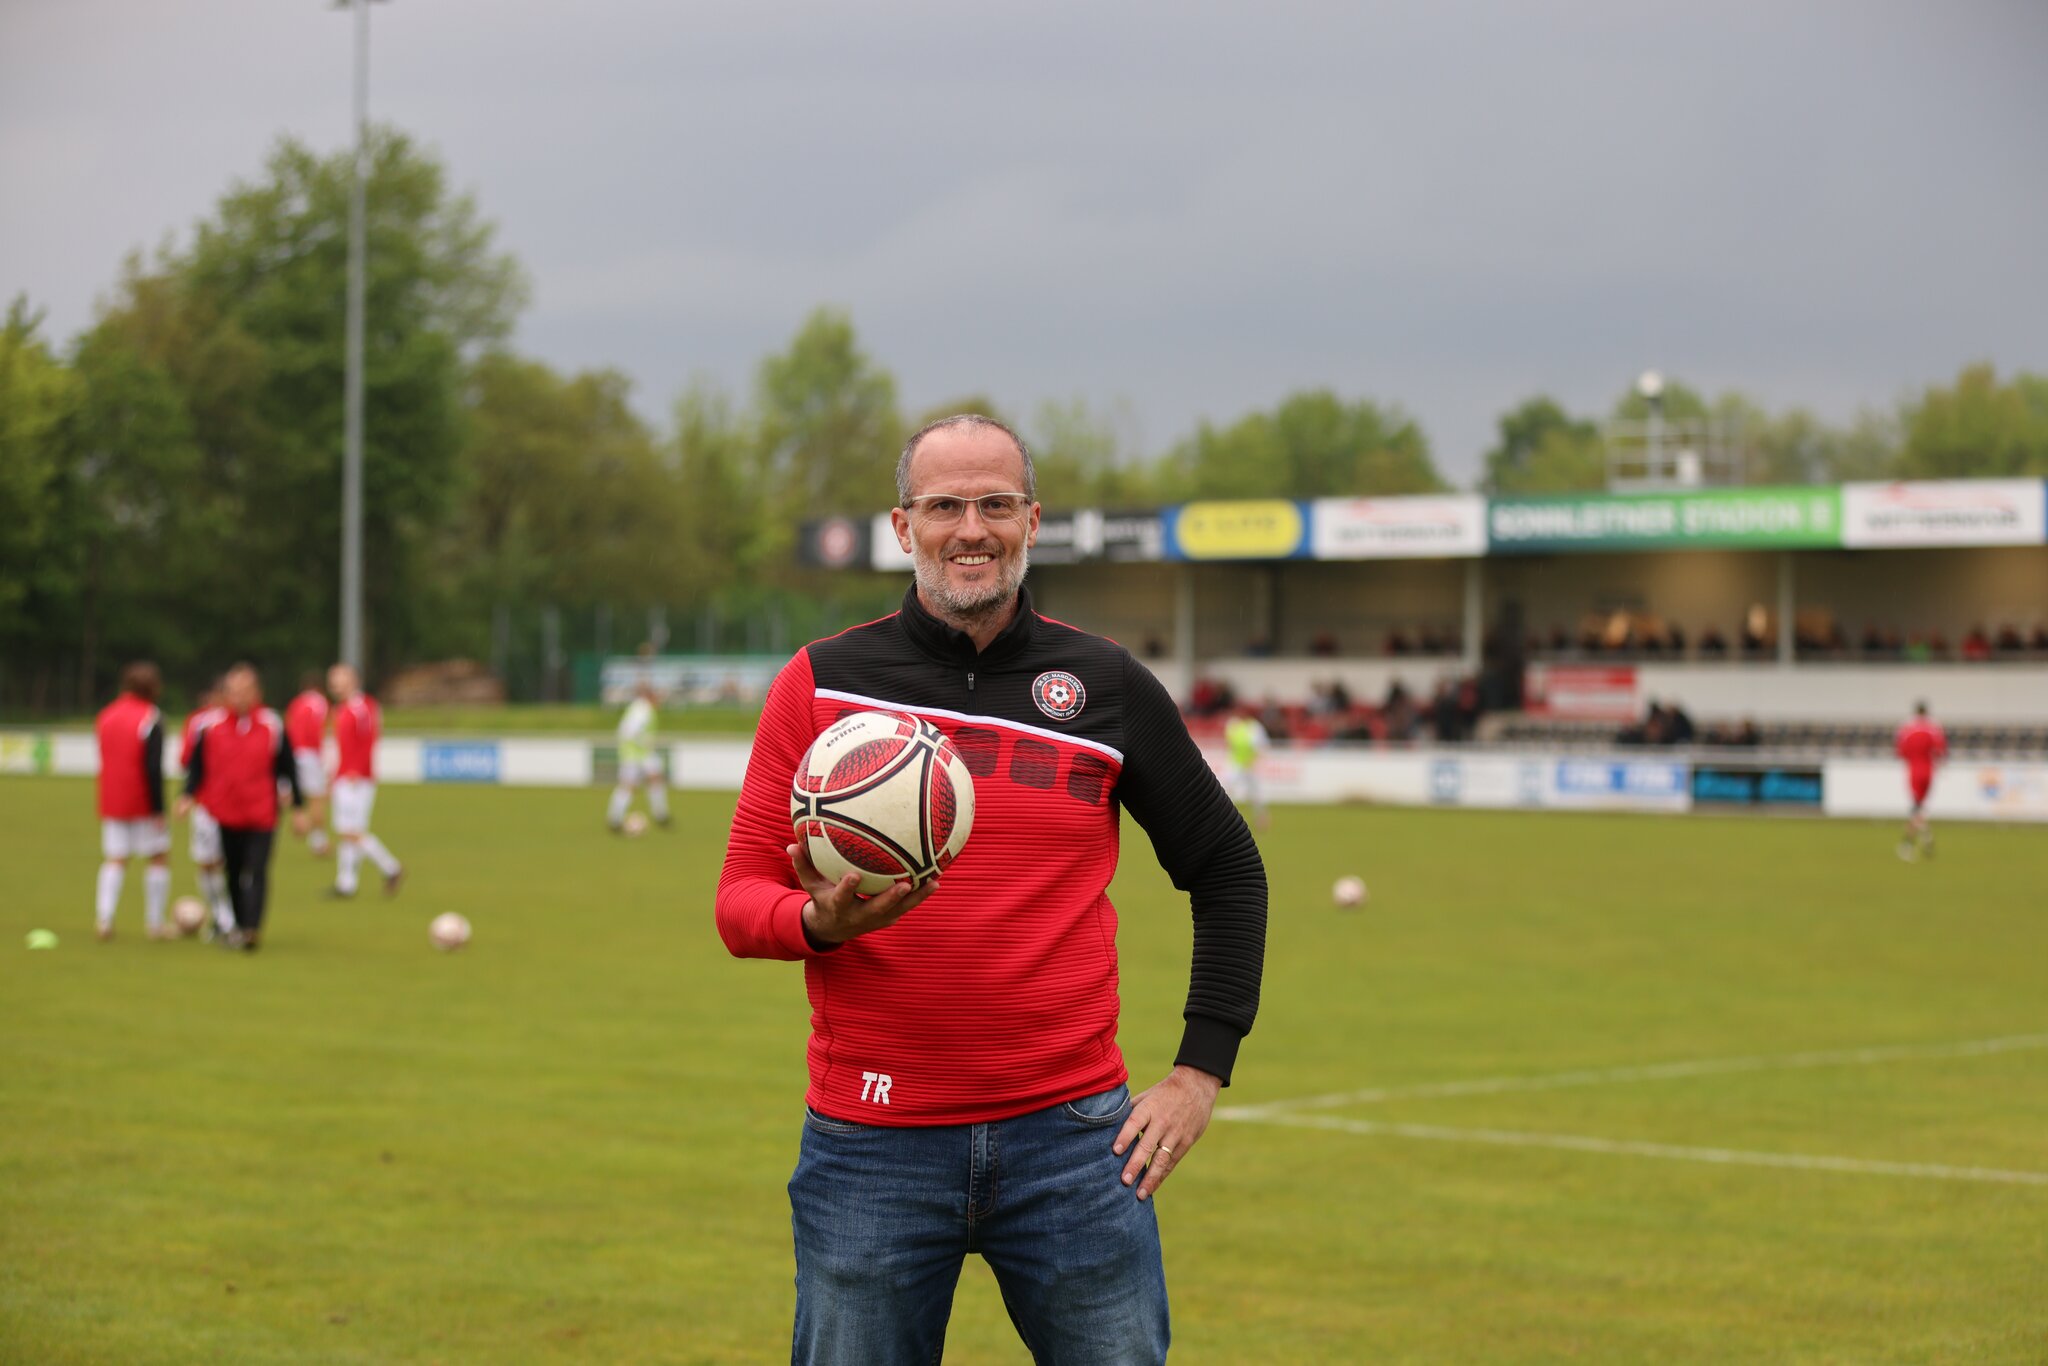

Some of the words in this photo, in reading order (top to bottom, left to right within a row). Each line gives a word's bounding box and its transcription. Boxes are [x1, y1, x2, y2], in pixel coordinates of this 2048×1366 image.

[1682, 499, 1801, 535] STADION
[1051, 673, 1081, 693] MAGDALENA
[827, 722, 866, 748] erima
[860, 1071, 893, 1105] TR
